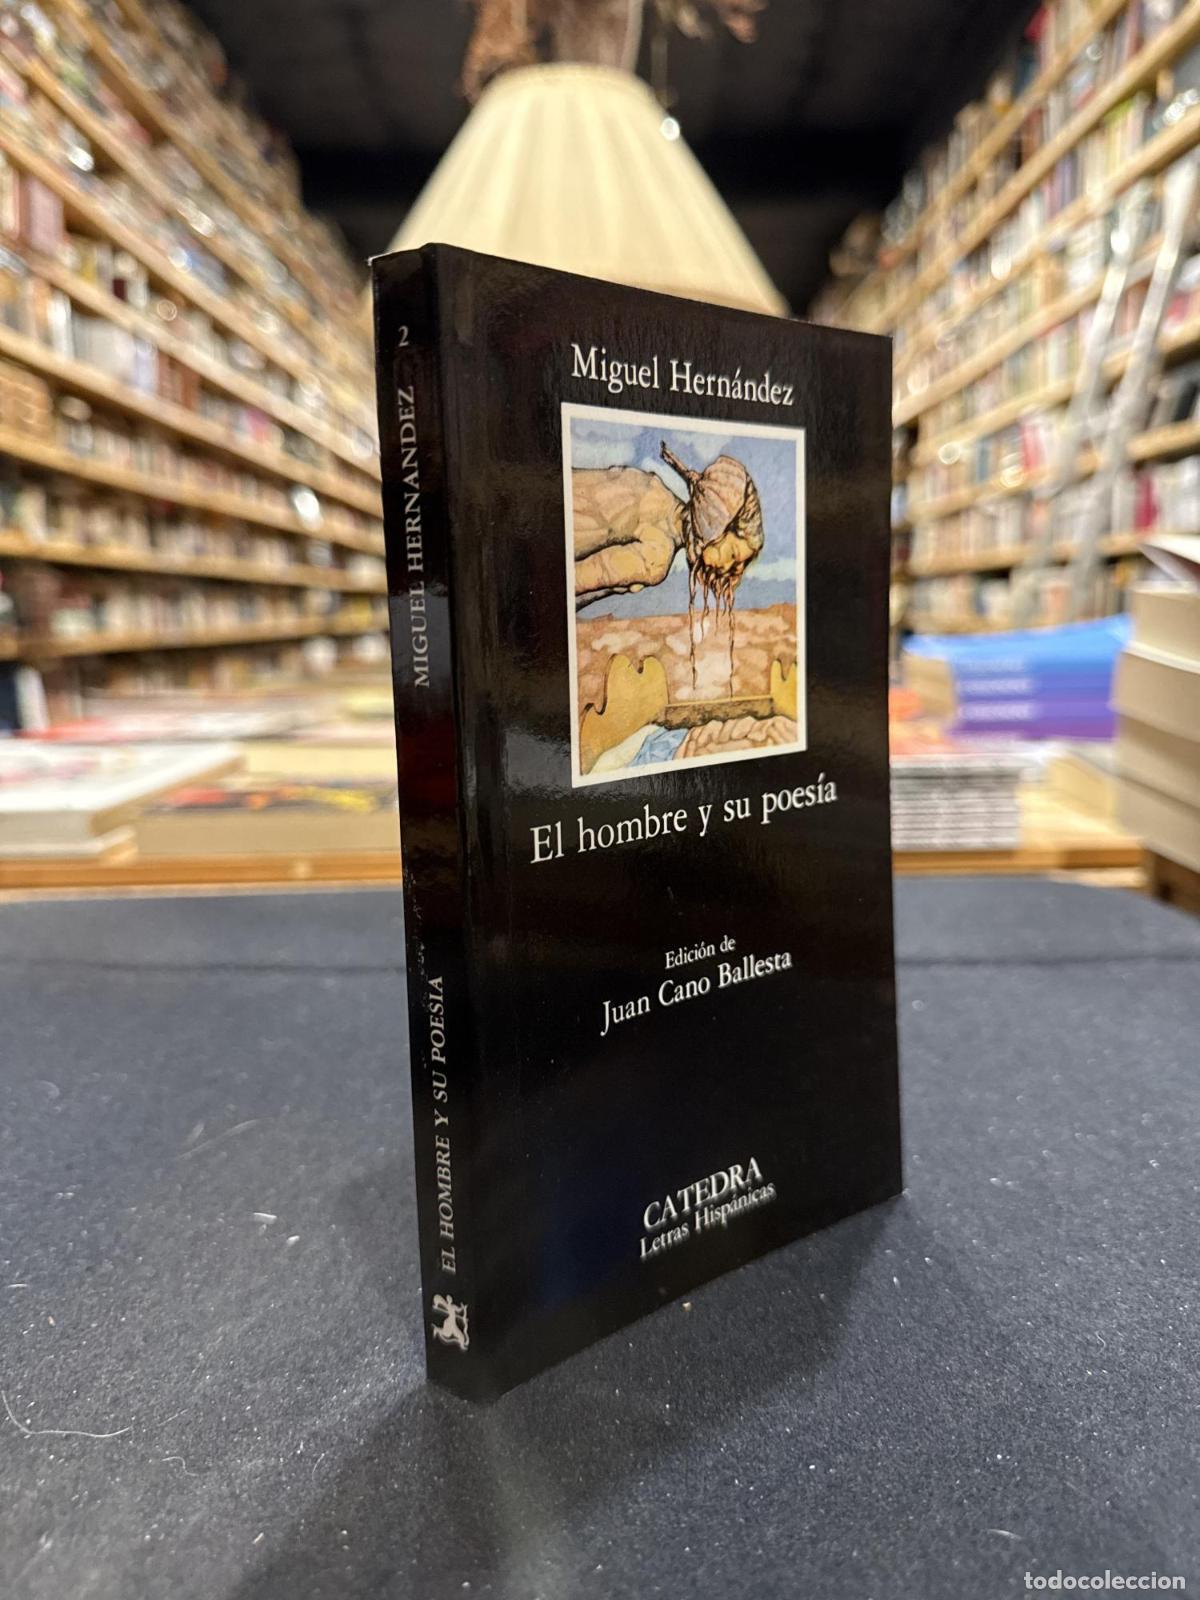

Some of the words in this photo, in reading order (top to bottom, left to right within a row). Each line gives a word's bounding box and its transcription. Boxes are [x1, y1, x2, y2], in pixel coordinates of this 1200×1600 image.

[398, 325, 410, 347] 2
[571, 343, 660, 393] Miguel
[669, 359, 794, 406] Hernández
[398, 385, 424, 572] HERNANDEZ
[408, 580, 431, 689] MIGUEL
[530, 821, 565, 864] El
[577, 803, 688, 853] hombre
[698, 804, 713, 837] y
[723, 797, 752, 822] su
[760, 772, 838, 825] poesía
[665, 941, 716, 969] Edición
[719, 935, 736, 953] de
[428, 976, 447, 1064] POESIA
[600, 996, 651, 1037] Juan
[658, 976, 711, 1006] Cano
[717, 952, 792, 988] Ballesta
[432, 1070, 449, 1103] SU
[433, 1108, 450, 1127] Y
[435, 1135, 455, 1239] HOMBRE
[640, 1220, 690, 1260] Letras
[693, 1180, 777, 1232] Hispánicas
[643, 1157, 764, 1231] CATEDRA
[440, 1246, 458, 1275] EL
